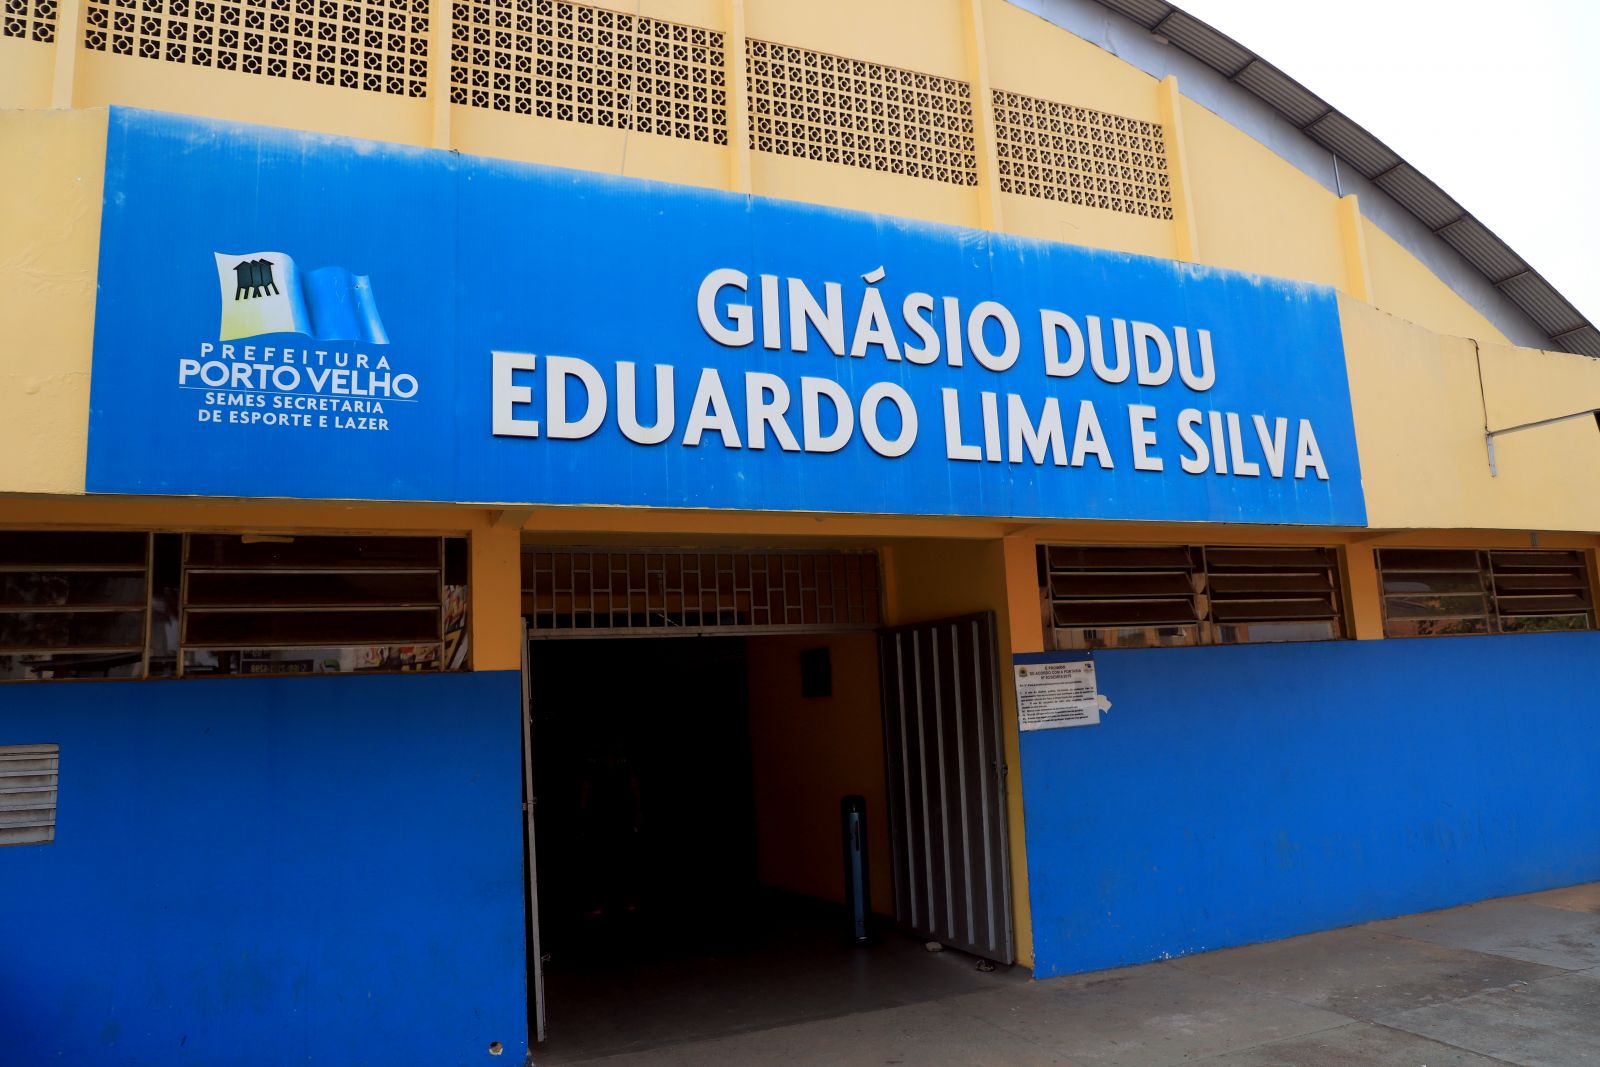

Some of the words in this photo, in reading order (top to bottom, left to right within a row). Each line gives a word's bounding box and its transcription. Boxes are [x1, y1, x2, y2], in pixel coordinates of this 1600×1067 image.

[697, 265, 1020, 372] GINÁSIO
[1040, 309, 1216, 391] DUDU
[200, 342, 390, 370] PREFEITURA
[178, 358, 301, 392] PORTO
[306, 366, 419, 399] VELHO
[197, 409, 223, 424] DE
[229, 411, 313, 428] ESPORTE
[318, 415, 328, 429] E
[335, 416, 390, 431] LAZER
[205, 391, 266, 408] SEMES
[273, 395, 385, 415] SECRETARIA
[491, 351, 918, 457] EDUARDO
[942, 387, 1114, 469] LIMA
[1128, 403, 1163, 472] E
[1177, 408, 1329, 480] SILVA
